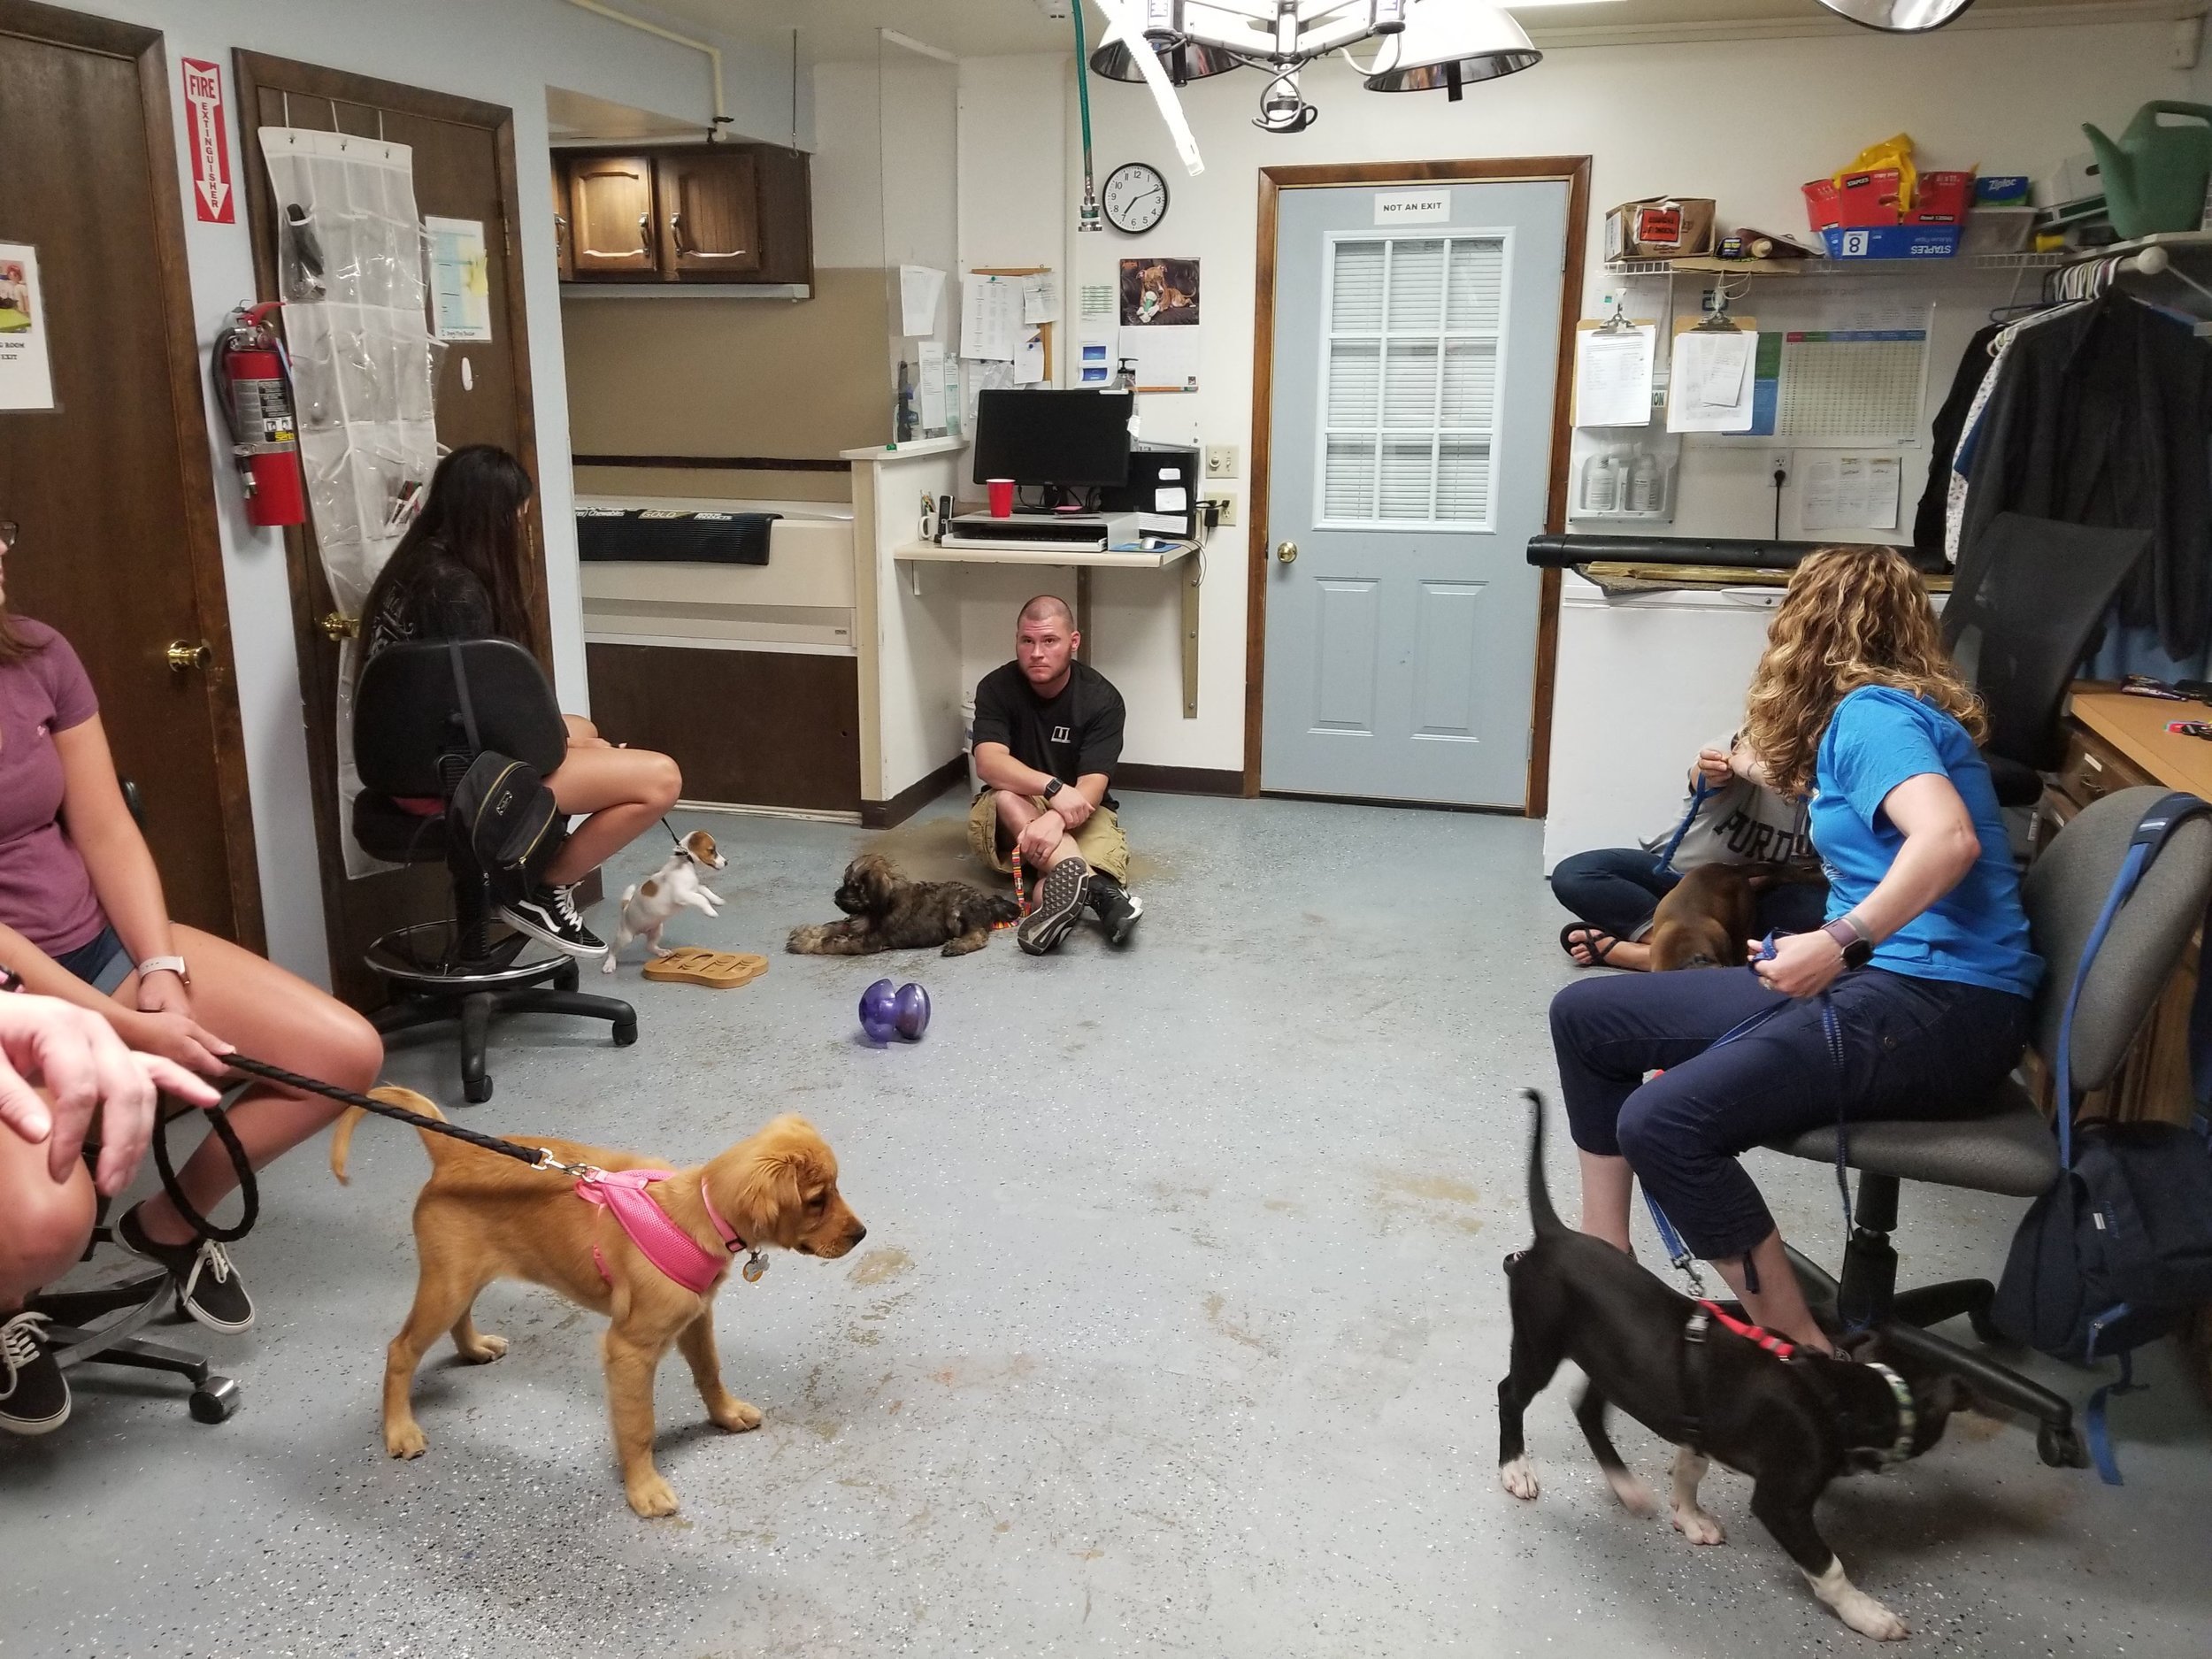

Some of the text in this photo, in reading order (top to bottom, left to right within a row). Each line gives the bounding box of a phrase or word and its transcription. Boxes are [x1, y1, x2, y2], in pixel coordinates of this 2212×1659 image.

[189, 74, 216, 99] FIRE
[202, 102, 219, 208] EXTINGUISHER
[1847, 177, 1870, 187] STAPLES
[1988, 178, 2016, 191] Ziploc
[1849, 237, 1861, 253] 8
[1911, 245, 1952, 255] STAPLES
